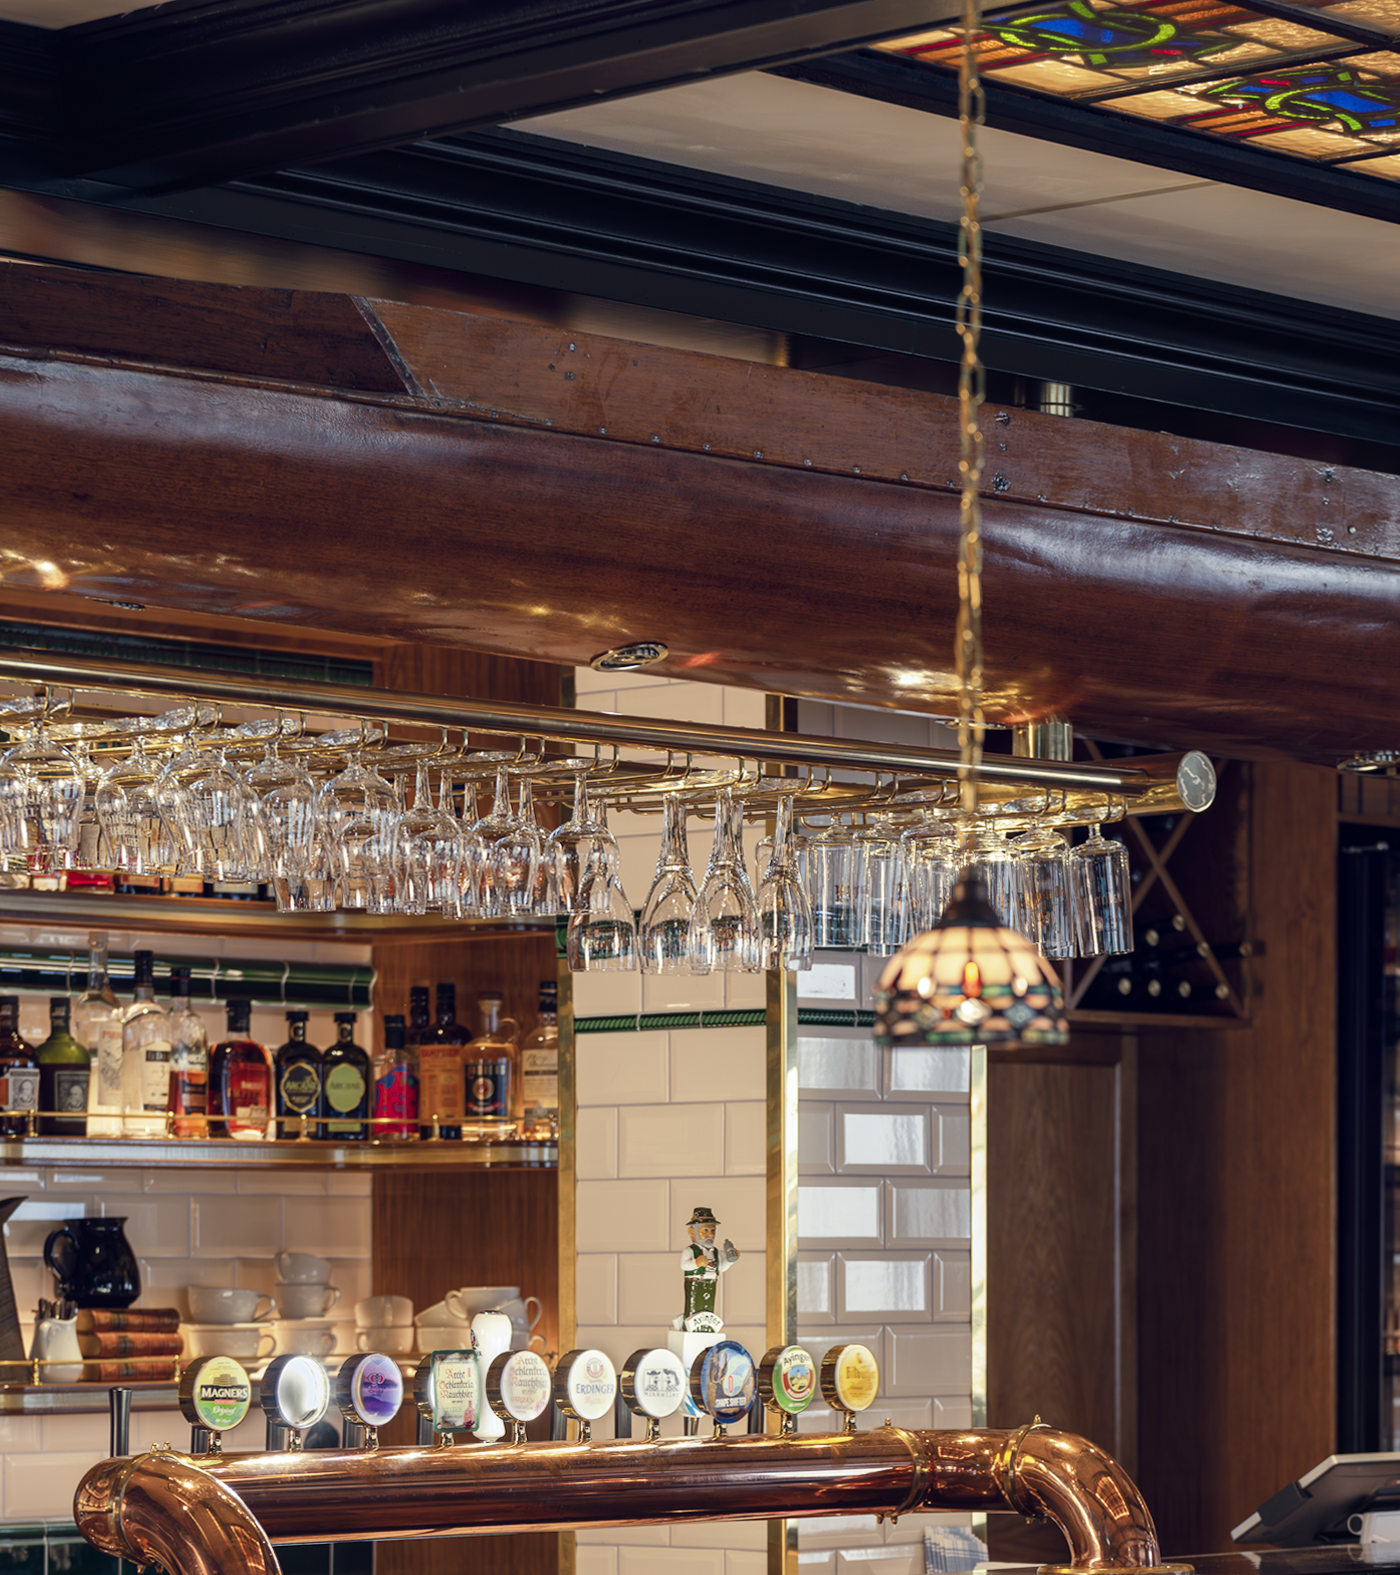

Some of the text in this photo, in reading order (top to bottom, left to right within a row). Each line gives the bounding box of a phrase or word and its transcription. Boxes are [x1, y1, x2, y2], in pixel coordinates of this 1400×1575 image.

[693, 1313, 721, 1326] Ayinger
[783, 1352, 811, 1367] Ayinger
[201, 1387, 248, 1399] MAGNERS
[576, 1383, 615, 1395] ERDINGER
[715, 1397, 747, 1408] SHAPE SHIFTER
[212, 1405, 237, 1417] Original
